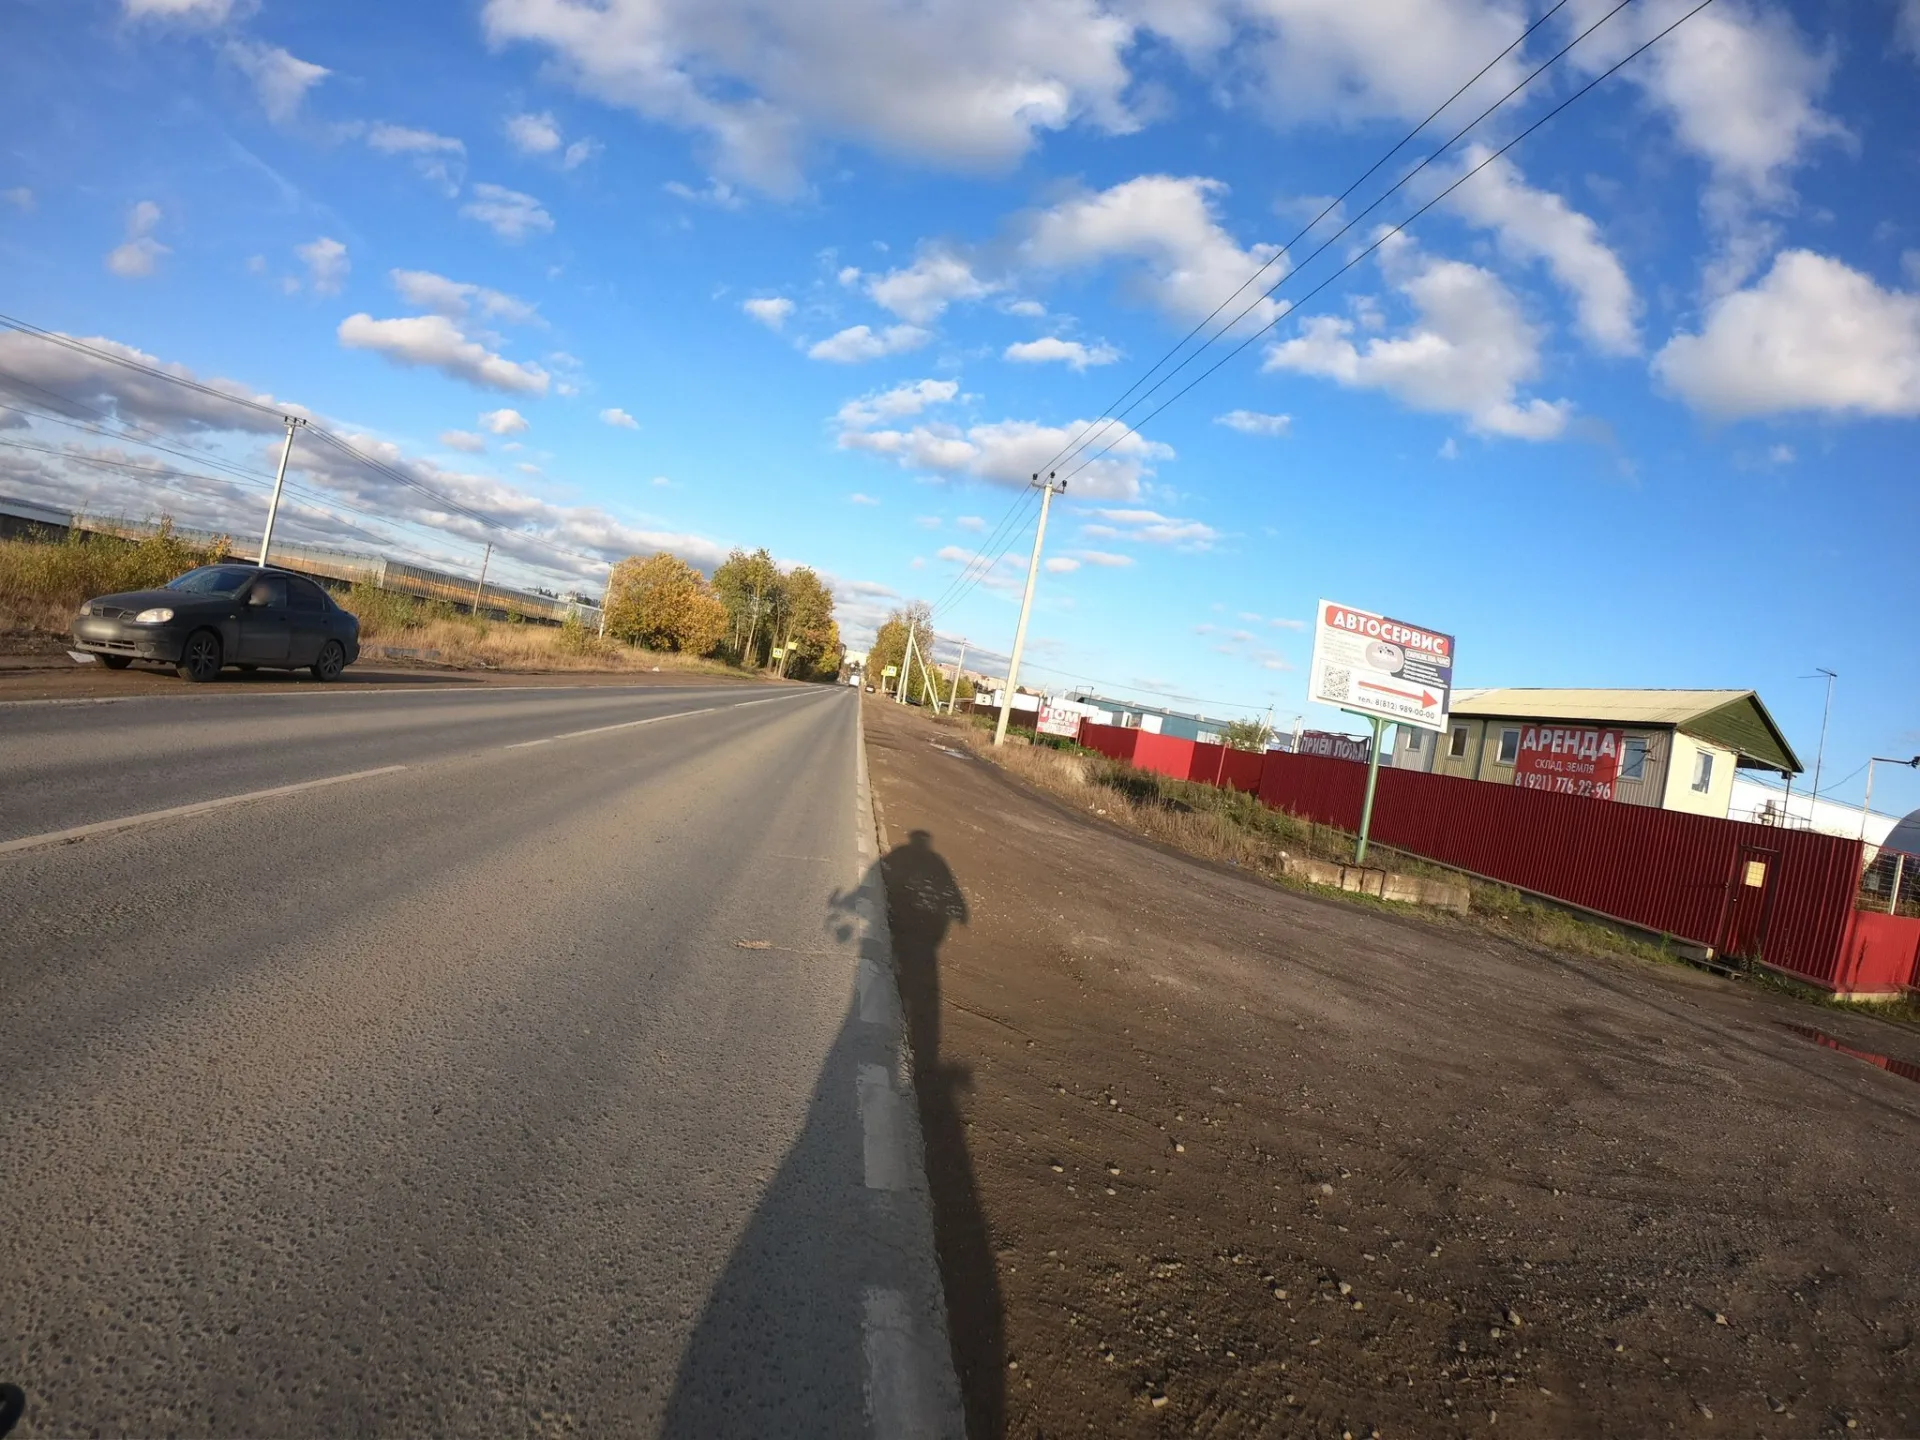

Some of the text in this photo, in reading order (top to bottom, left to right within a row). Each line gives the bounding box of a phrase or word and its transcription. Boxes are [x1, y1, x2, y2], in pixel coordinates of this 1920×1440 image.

[1333, 611, 1445, 655] АВТОСЕРВИС
[1041, 708, 1079, 723] ЛОМ
[1522, 729, 1615, 761] АРЕНДА
[1535, 759, 1595, 774] СКЛАД ЗЕМЛЯ
